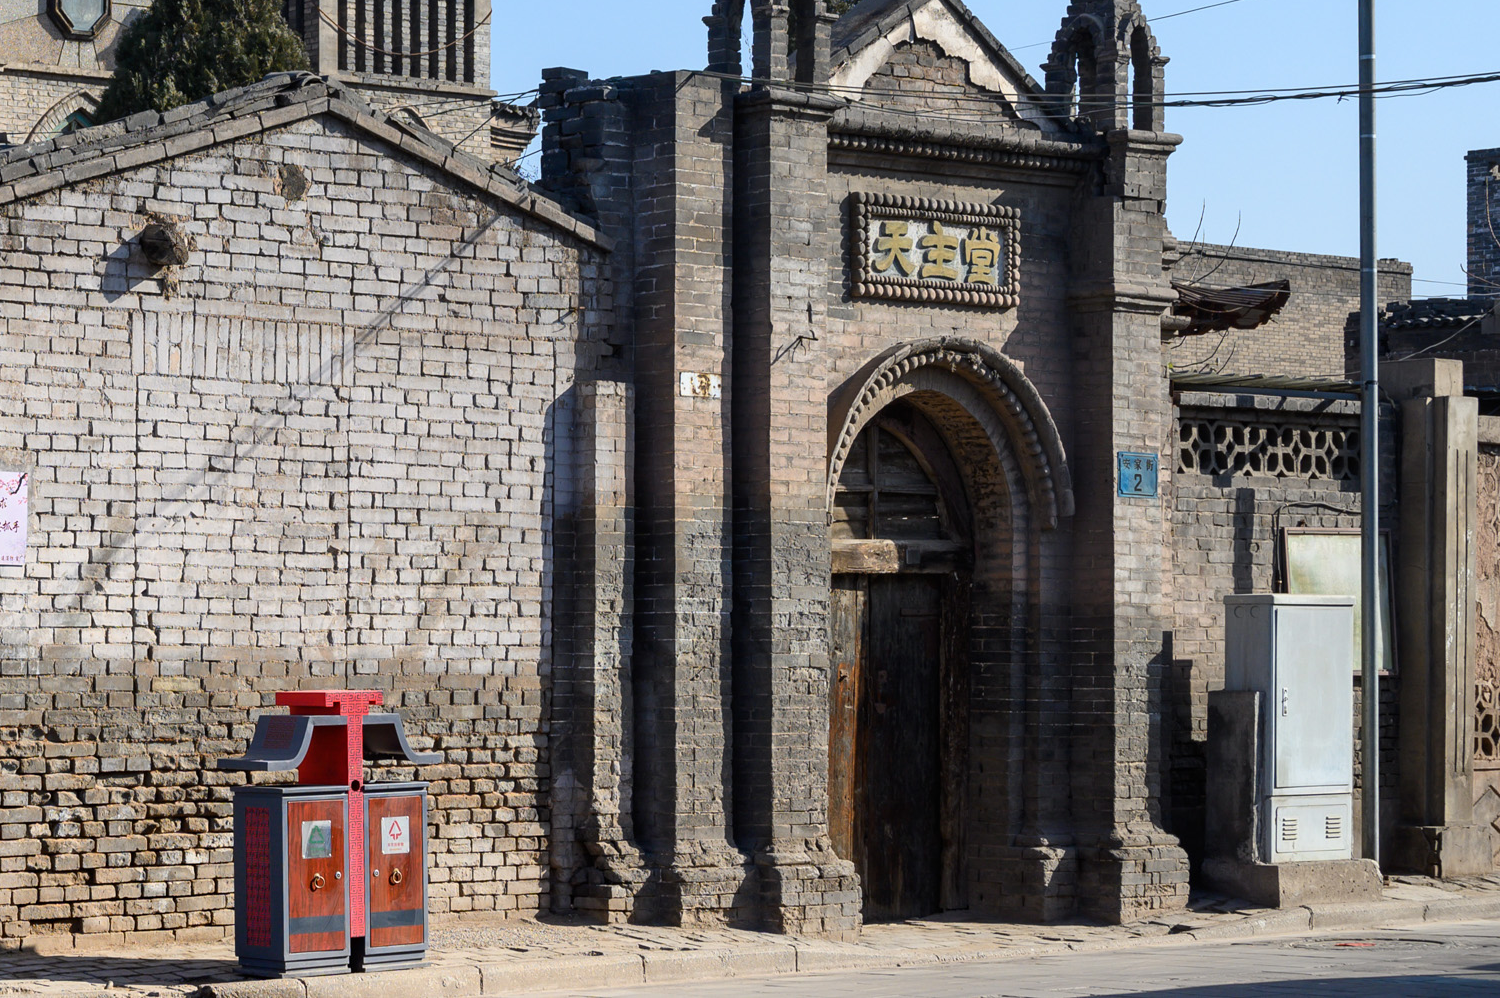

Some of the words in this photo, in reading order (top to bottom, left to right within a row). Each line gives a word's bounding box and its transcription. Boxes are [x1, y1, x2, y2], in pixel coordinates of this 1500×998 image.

[873, 220, 1001, 286] 天主堂
[1134, 474, 1142, 491] 2
